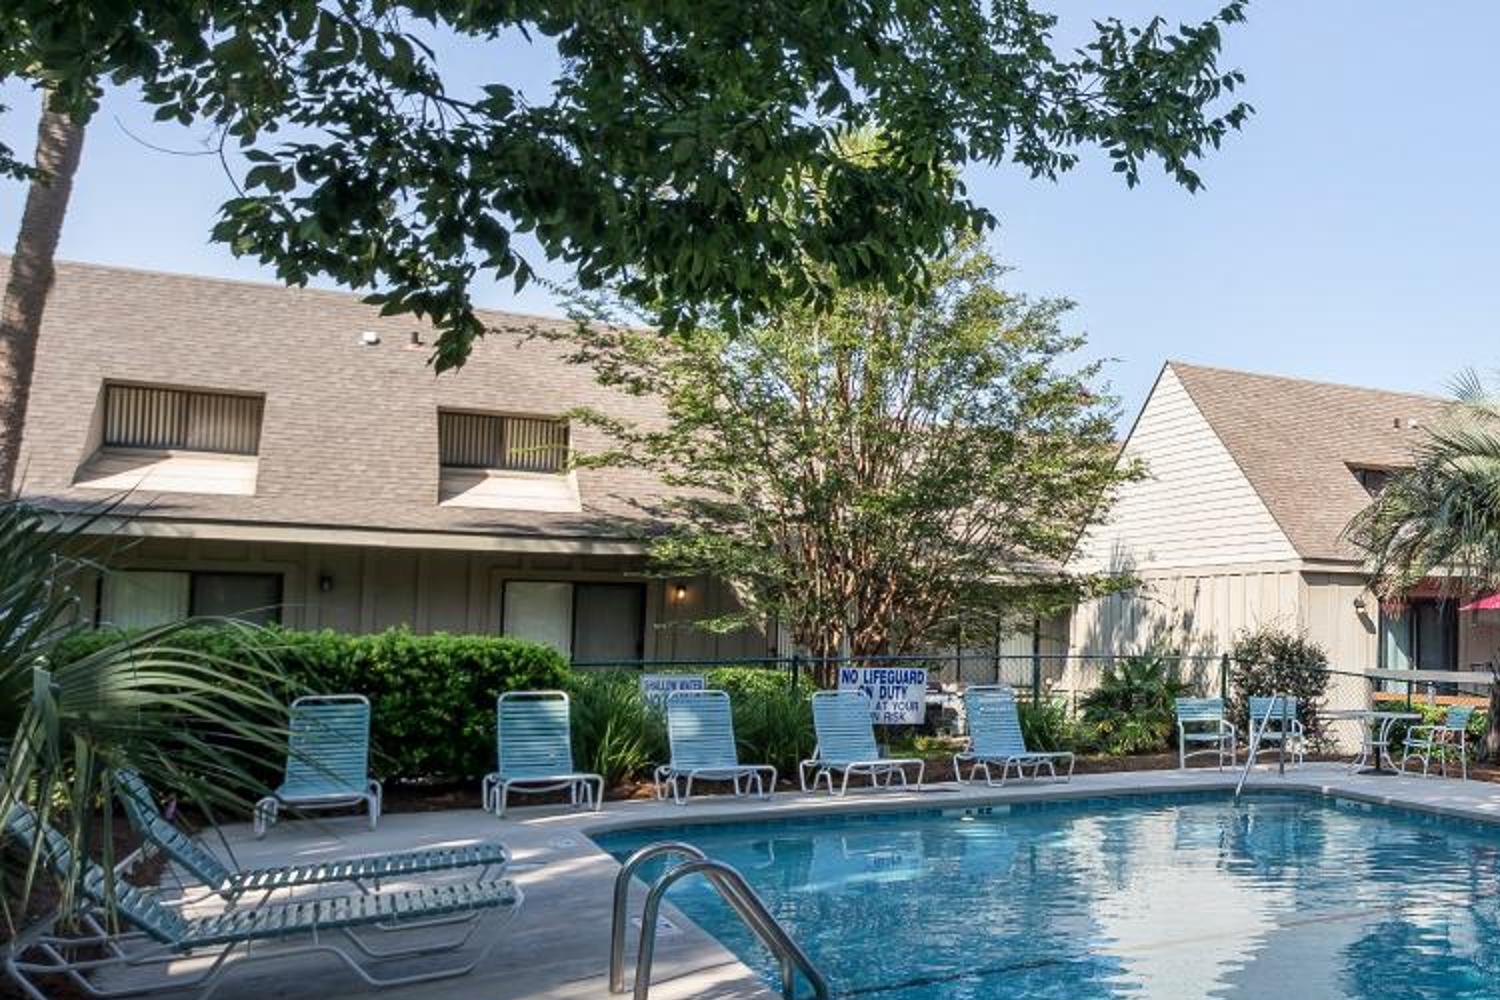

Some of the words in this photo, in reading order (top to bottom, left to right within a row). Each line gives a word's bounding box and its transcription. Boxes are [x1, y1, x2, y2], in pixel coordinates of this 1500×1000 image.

[841, 669, 859, 684] NO
[863, 669, 925, 685] LIFEGUARD
[879, 685, 908, 700] DUTY
